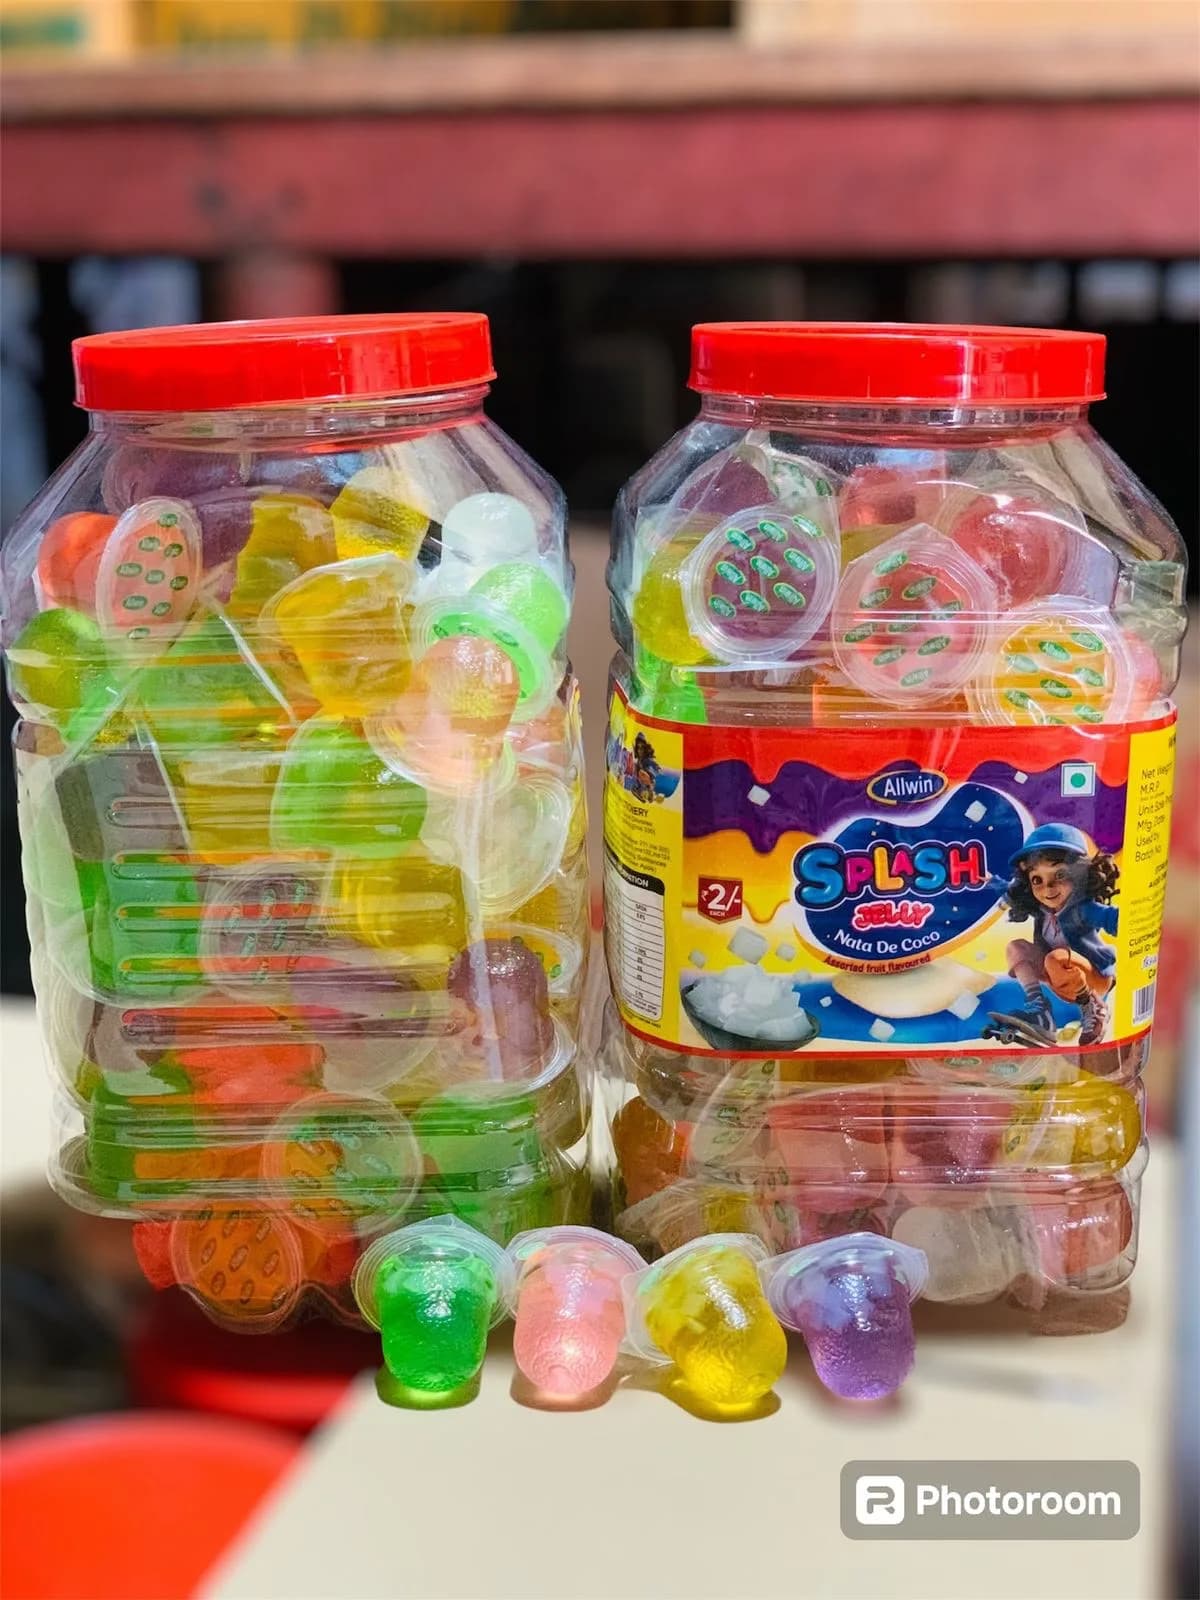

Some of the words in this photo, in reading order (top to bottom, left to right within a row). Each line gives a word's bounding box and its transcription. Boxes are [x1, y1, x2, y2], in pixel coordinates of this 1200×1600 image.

[884, 776, 933, 797] Allwin
[798, 845, 984, 906] SPLASH
[853, 900, 933, 930] JELLY
[833, 929, 873, 953] Nata
[876, 942, 898, 954] De
[901, 931, 941, 950] Coco
[824, 956, 864, 974] Assorted
[866, 963, 886, 973] fruit
[888, 954, 931, 973] flavoured
